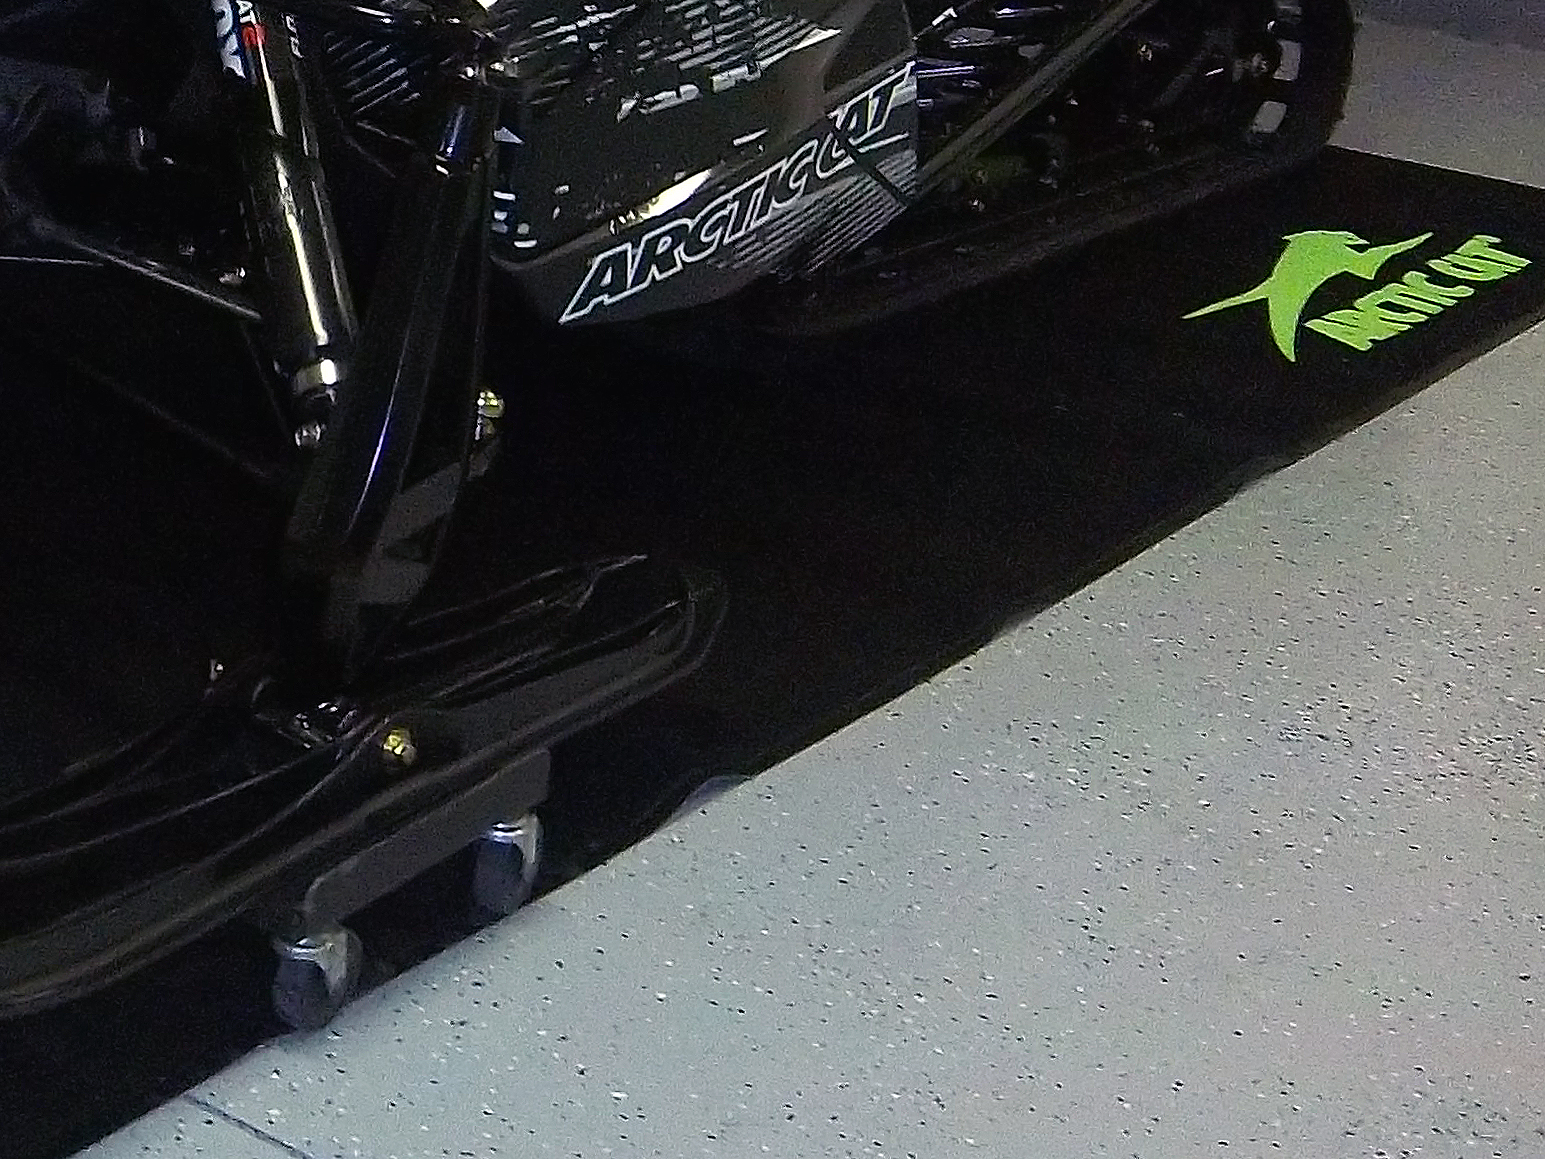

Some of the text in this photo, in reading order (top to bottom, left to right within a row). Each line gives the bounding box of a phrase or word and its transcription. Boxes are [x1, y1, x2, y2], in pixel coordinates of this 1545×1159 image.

[558, 138, 819, 324] ARCTIC
[1304, 234, 1533, 352] ARCTIC CAT
